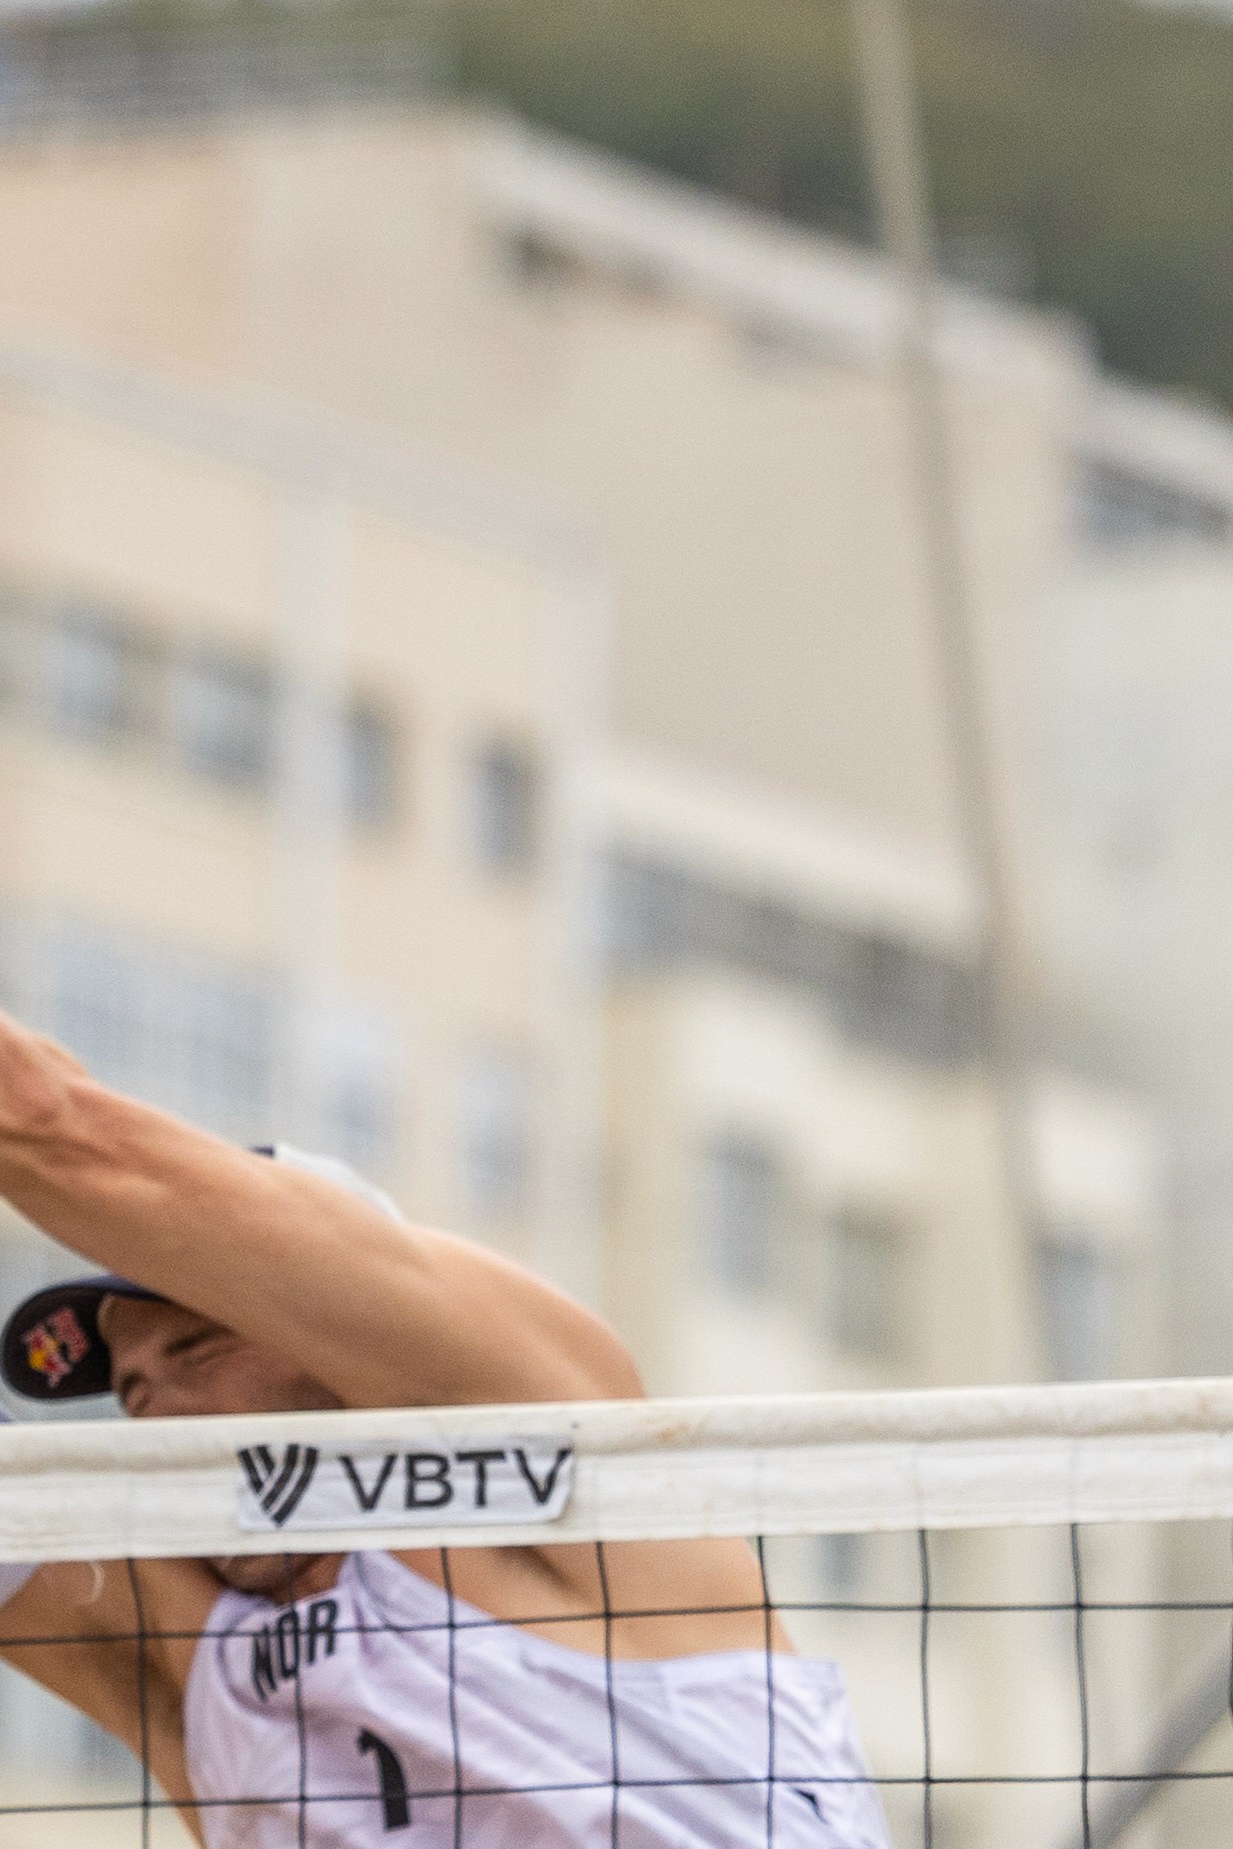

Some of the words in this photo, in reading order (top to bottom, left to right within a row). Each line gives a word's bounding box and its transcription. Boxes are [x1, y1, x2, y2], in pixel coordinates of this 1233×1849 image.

[337, 1446, 575, 1514] VBTV
[251, 1598, 338, 1702] NOR
[356, 1727, 412, 1834] 1
